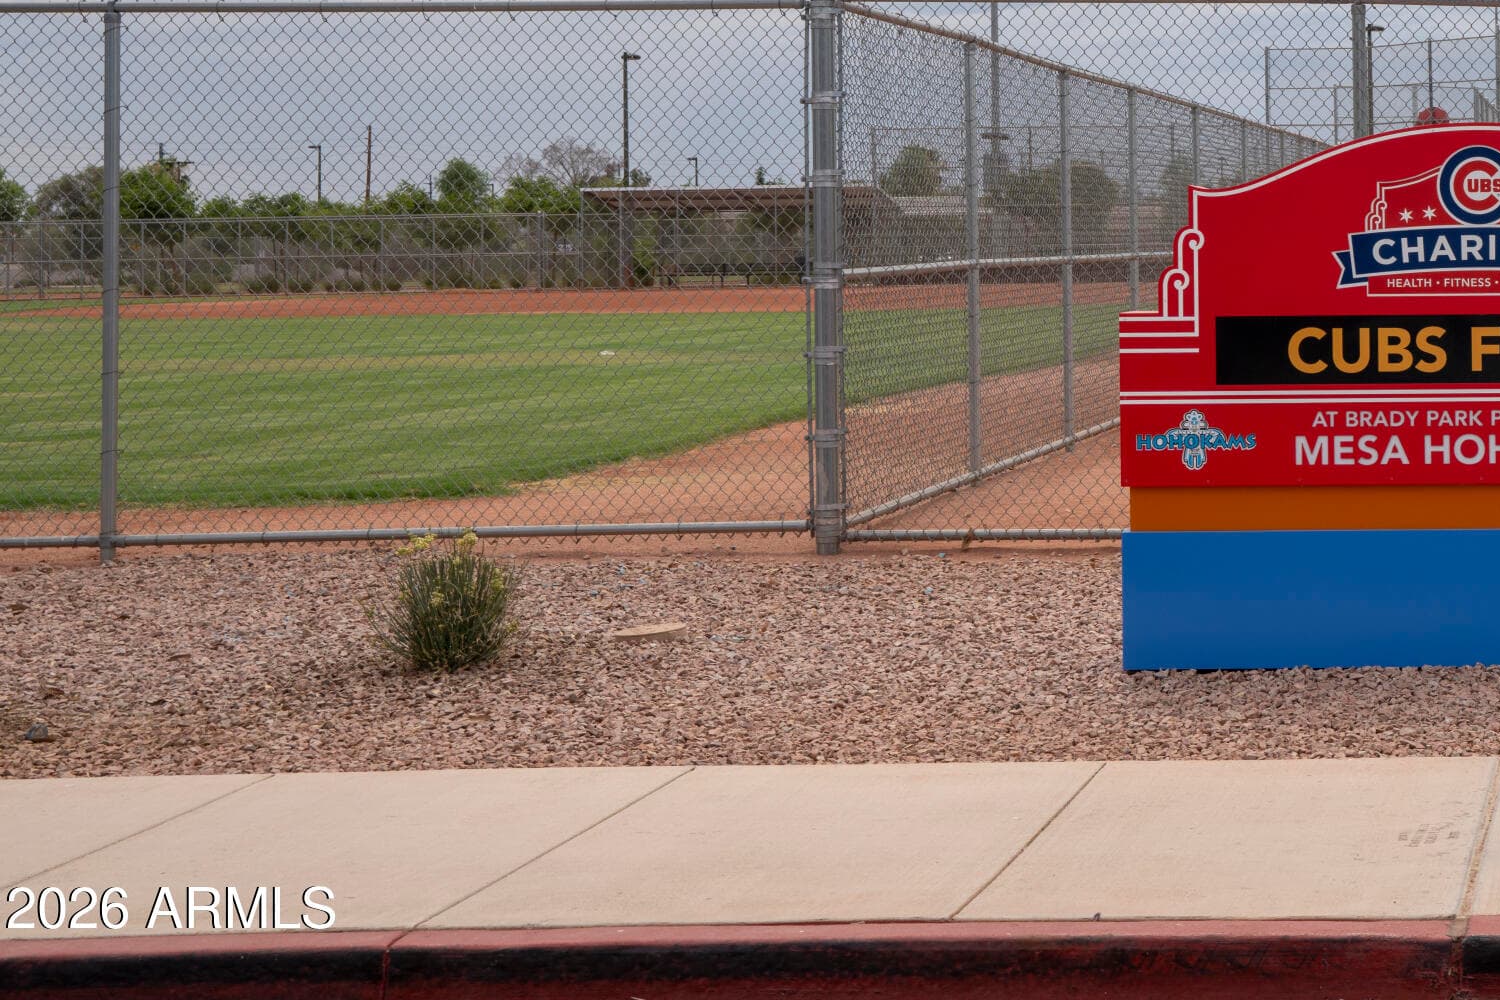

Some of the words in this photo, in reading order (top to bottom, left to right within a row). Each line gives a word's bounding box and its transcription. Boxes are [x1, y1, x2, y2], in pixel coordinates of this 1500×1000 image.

[1386, 277, 1432, 288] HEALTH
[1443, 277, 1492, 288] FITNESS
[1287, 326, 1447, 374] CUBS
[1312, 411, 1338, 428] AT
[1345, 410, 1419, 428] BRADY
[1426, 410, 1483, 427] PARK
[1135, 432, 1257, 451] HOHOKAMS
[1295, 434, 1410, 466] MESA
